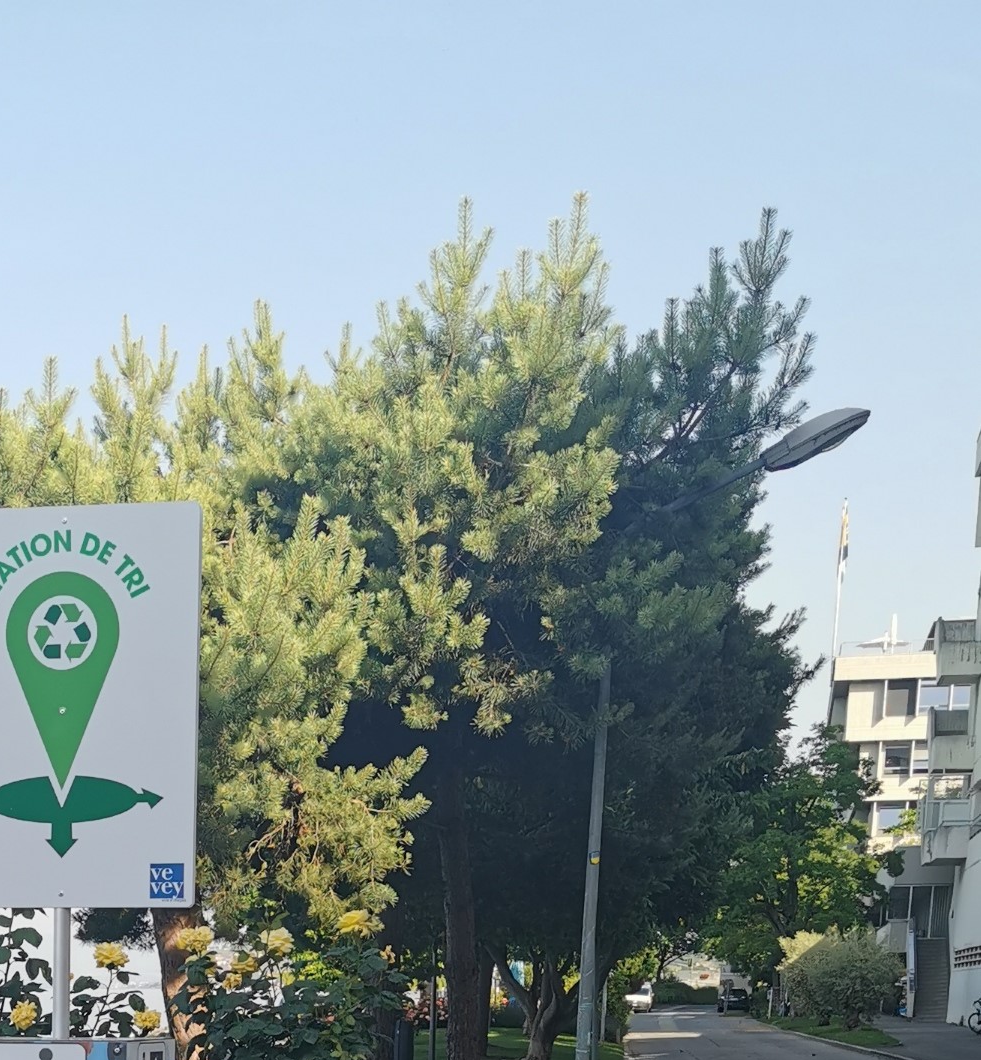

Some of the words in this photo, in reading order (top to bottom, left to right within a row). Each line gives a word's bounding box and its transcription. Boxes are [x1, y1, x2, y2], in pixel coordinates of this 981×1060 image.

[79, 532, 117, 565] DE
[114, 553, 151, 598] TRI
[150, 867, 173, 880] ve
[150, 881, 184, 899] vey
